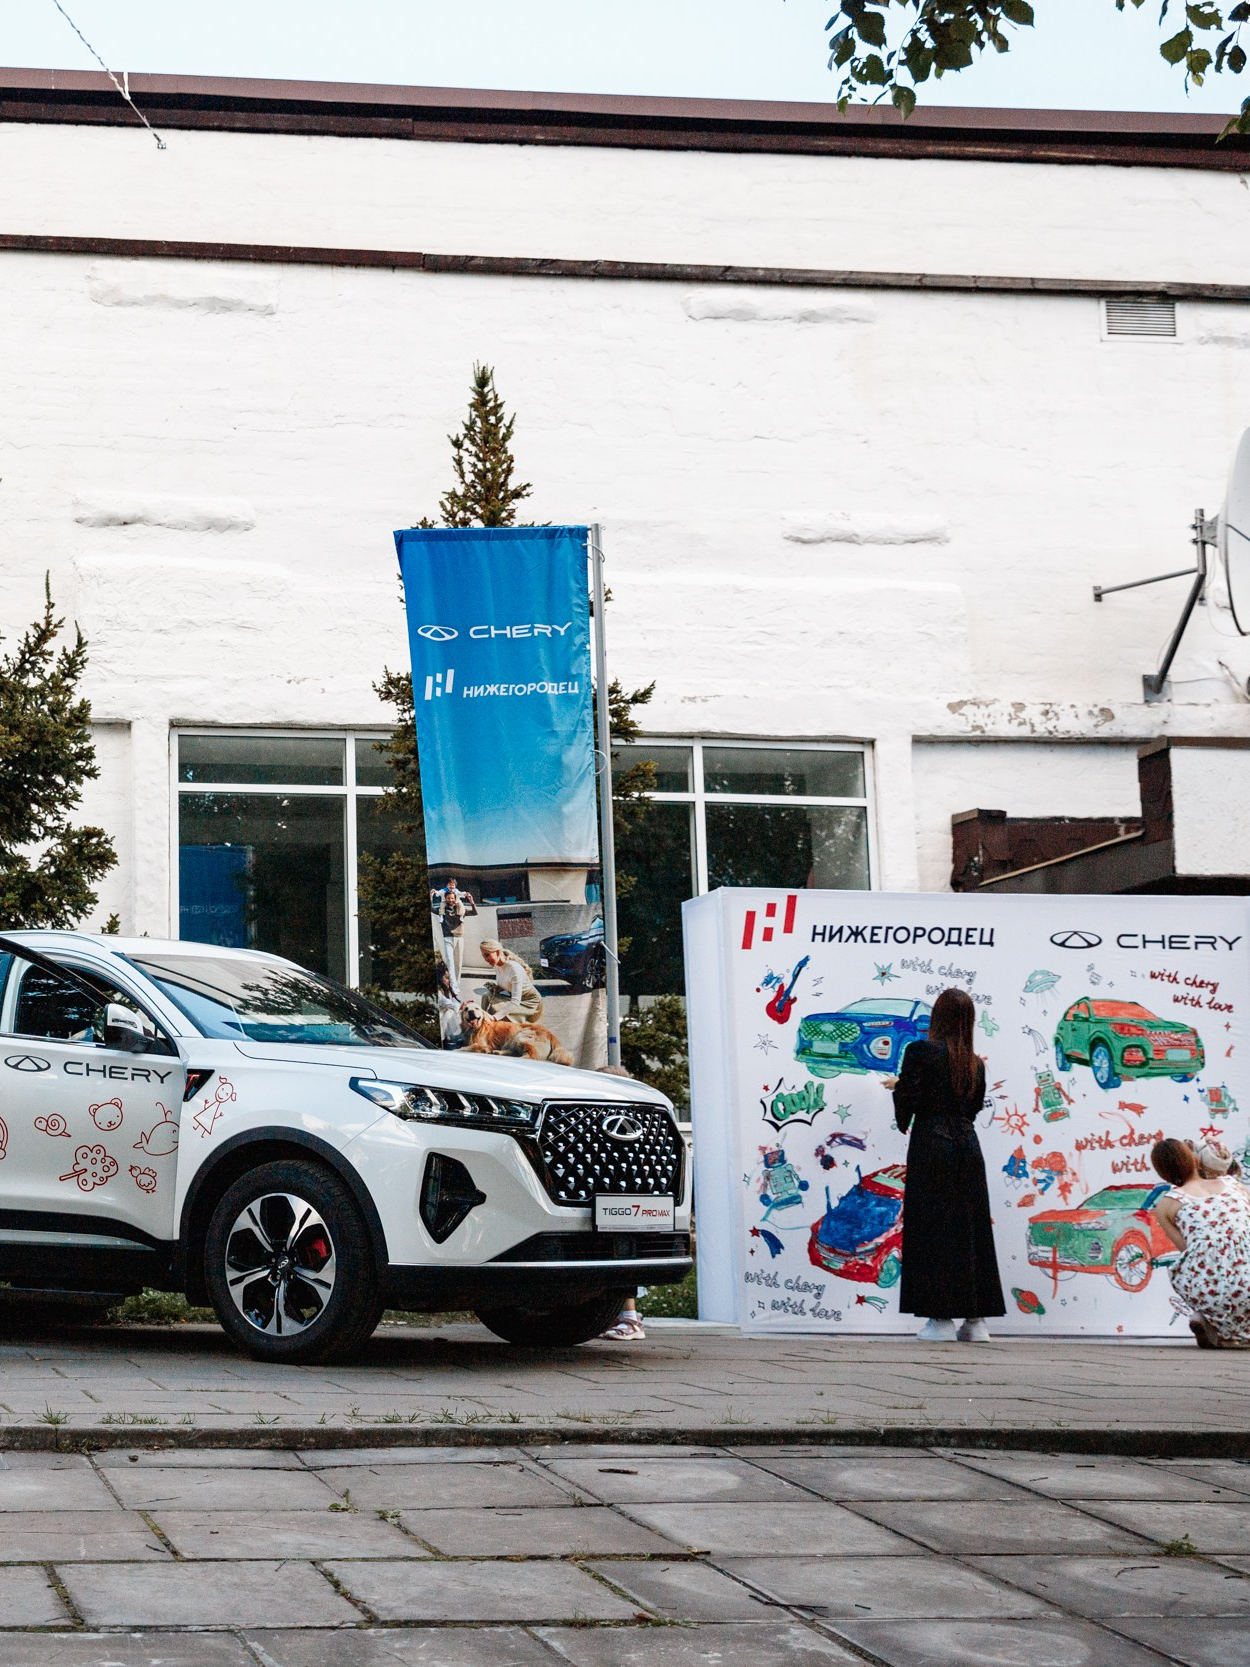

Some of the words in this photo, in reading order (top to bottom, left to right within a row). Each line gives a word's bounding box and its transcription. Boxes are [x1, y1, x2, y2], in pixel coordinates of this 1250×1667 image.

[469, 622, 572, 639] CHERY
[462, 681, 579, 698] НИЖЕГОРОДЕЦ
[811, 924, 995, 947] НИЖЕГОРОДЕЦ
[1116, 933, 1242, 951] CHERY
[1150, 968, 1180, 985] with
[1184, 974, 1219, 994] chery
[1173, 992, 1203, 1009] with
[1206, 999, 1234, 1014] love
[63, 1061, 172, 1084] CHERY
[1075, 1130, 1115, 1151] with
[1111, 1154, 1150, 1174] with
[602, 1208, 631, 1216] TIGGO
[632, 1204, 641, 1217] 7
